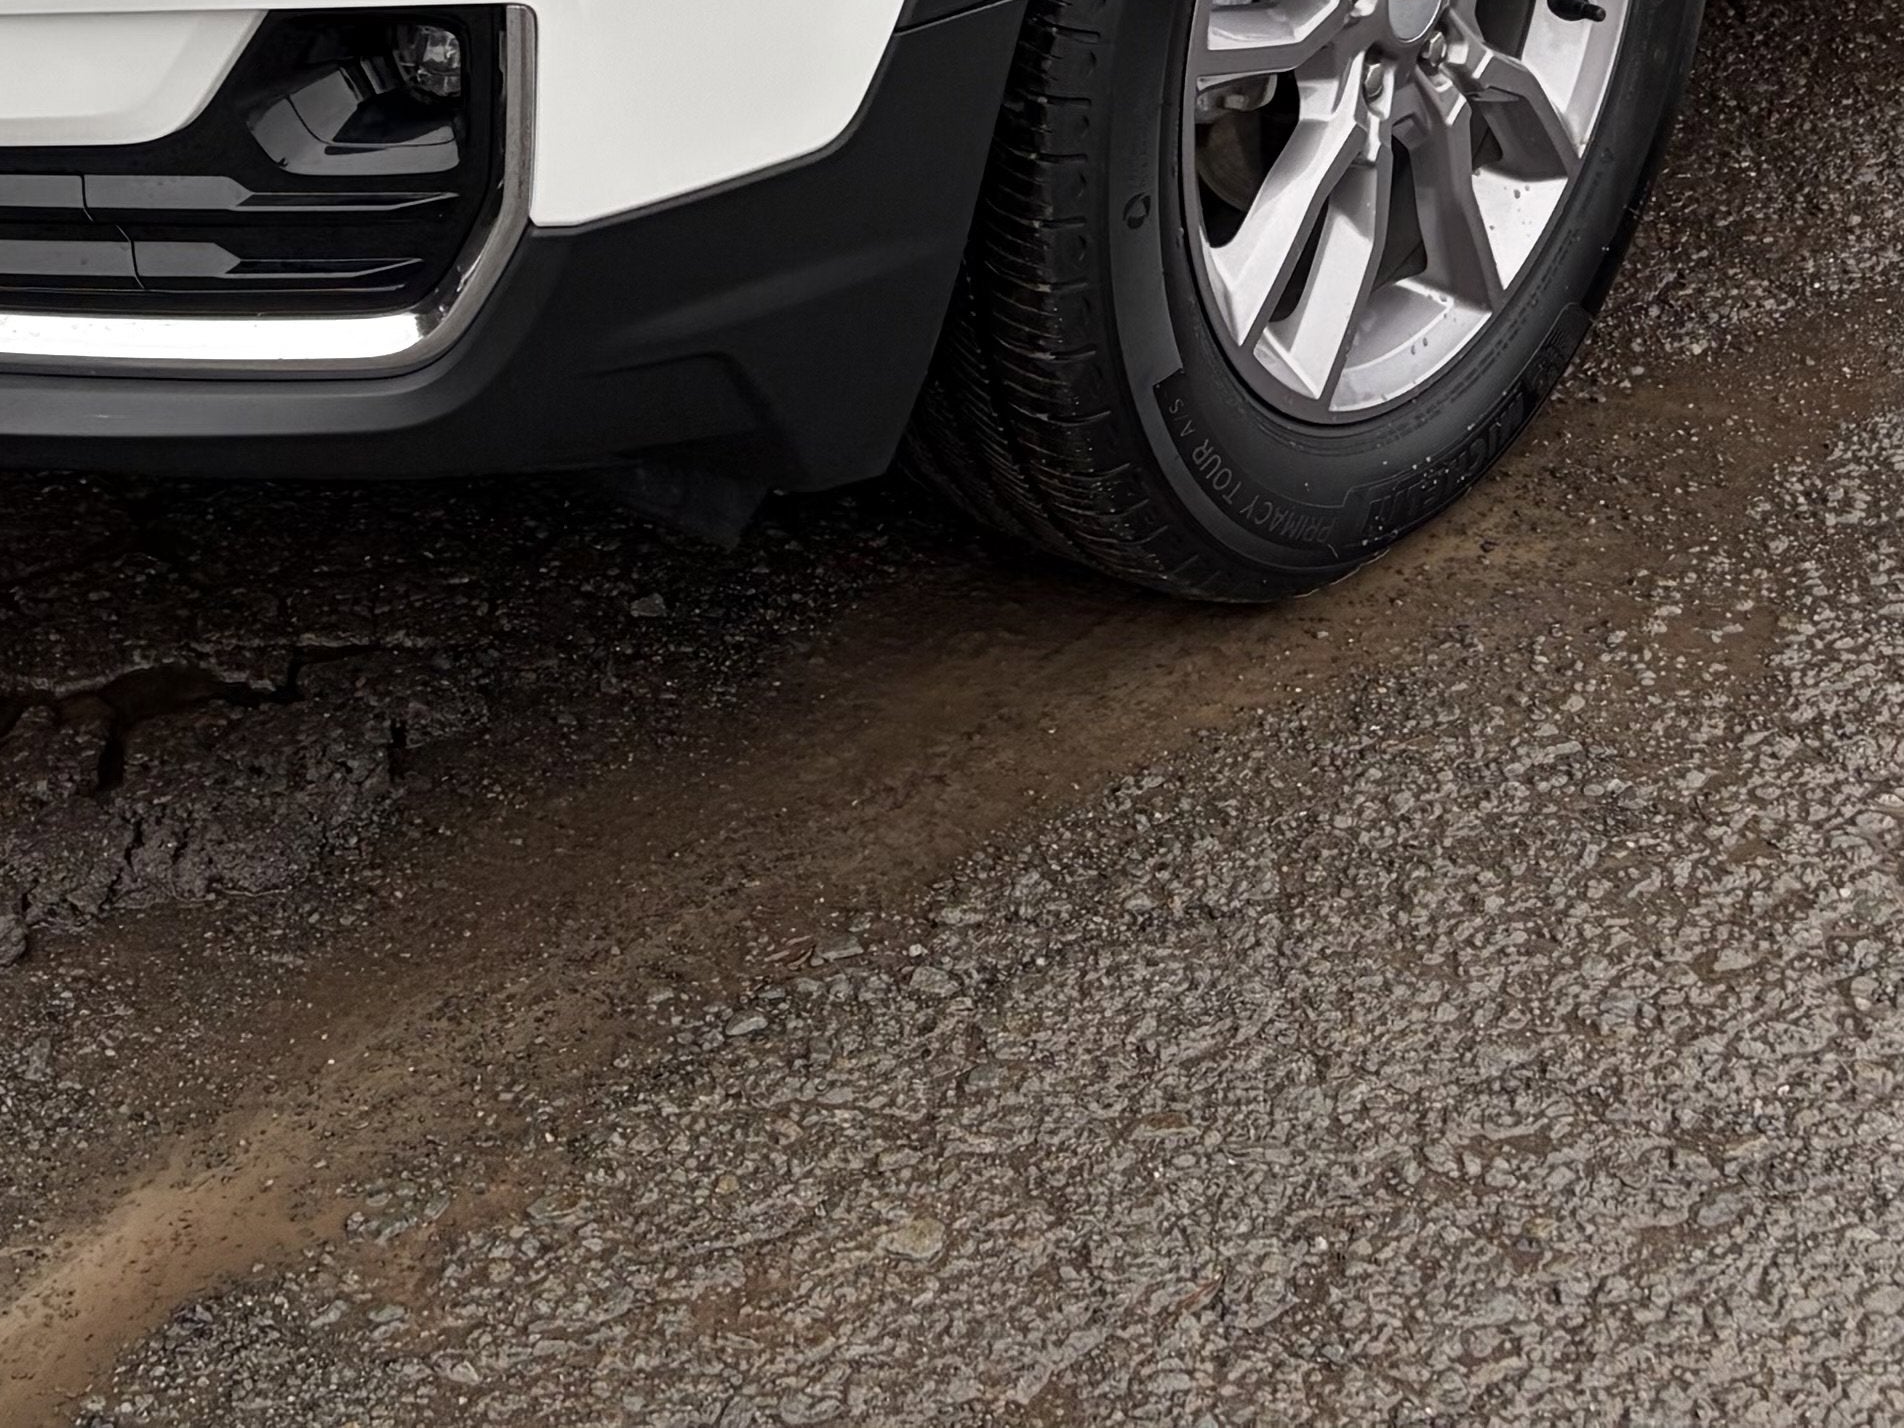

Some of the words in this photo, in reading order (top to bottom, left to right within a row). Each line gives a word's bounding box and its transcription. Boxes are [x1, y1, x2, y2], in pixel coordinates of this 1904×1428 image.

[1168, 398, 1196, 437] A/S
[1192, 439, 1243, 504] TOUR
[1239, 494, 1337, 543] PRIMACY
